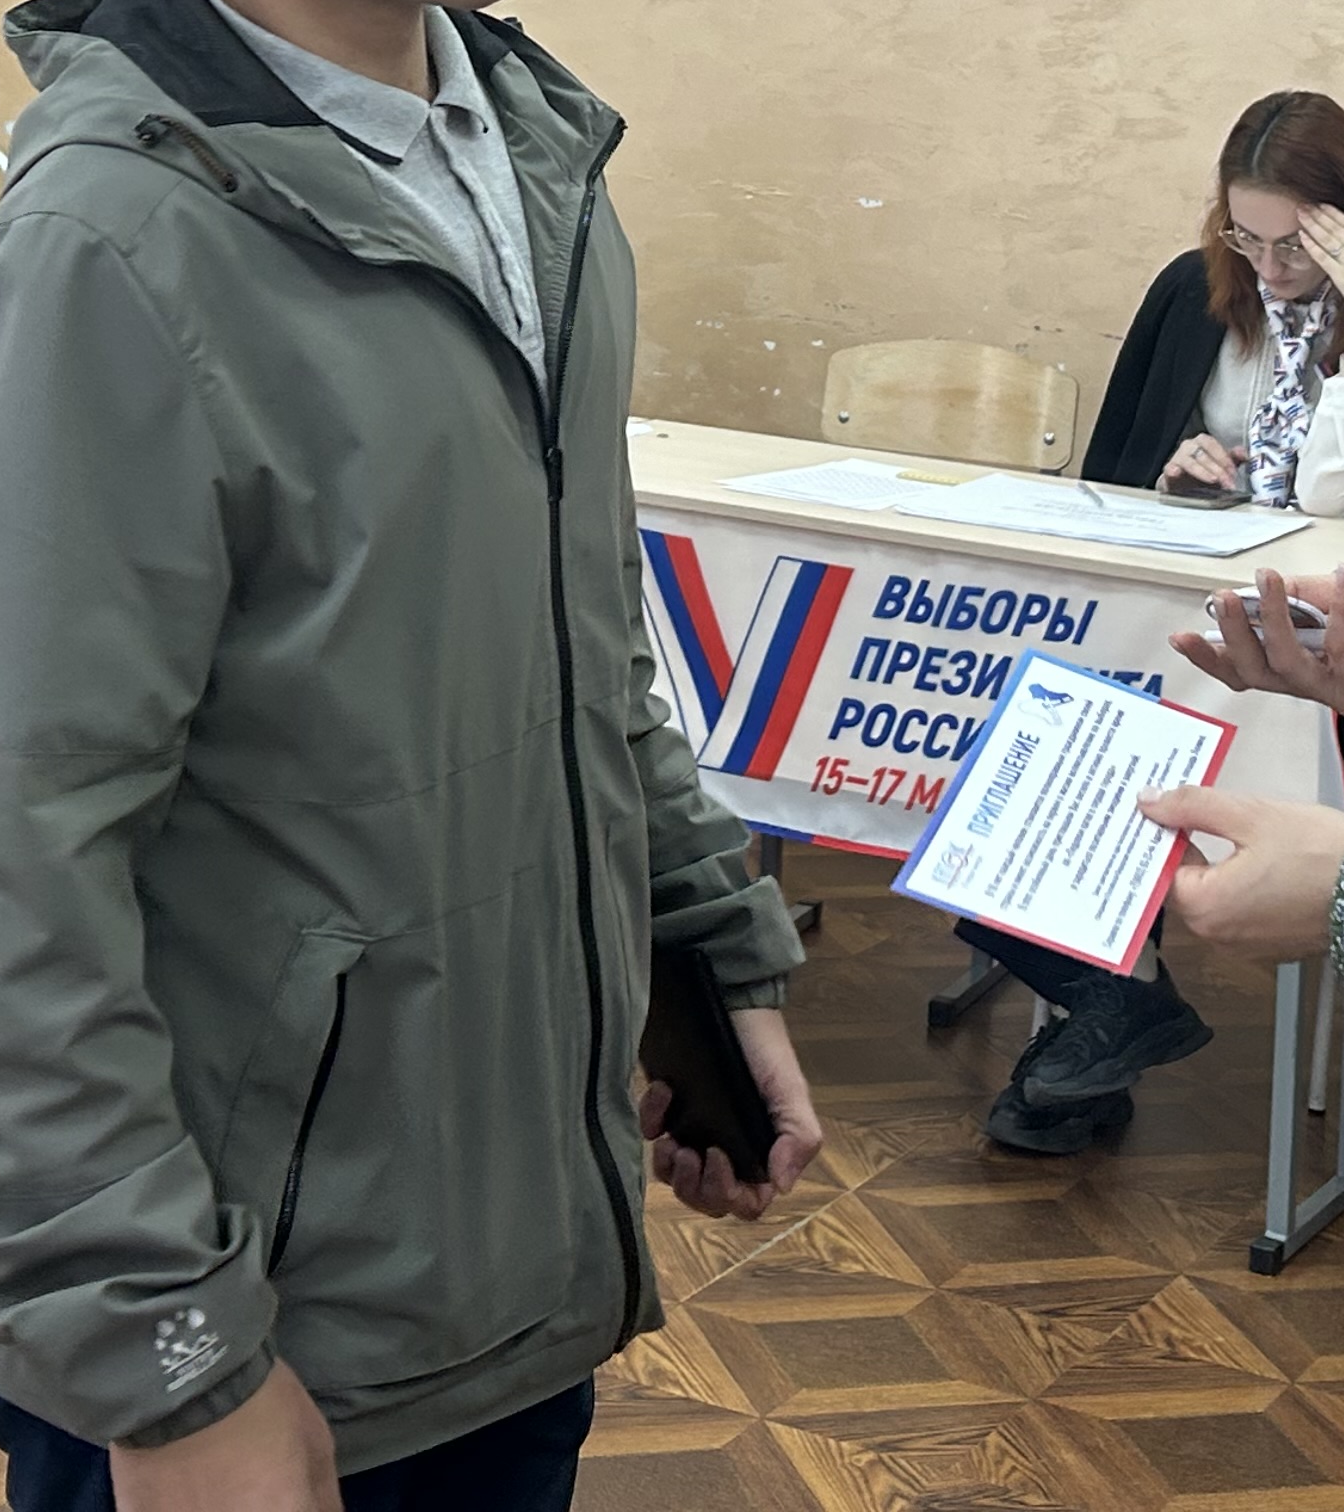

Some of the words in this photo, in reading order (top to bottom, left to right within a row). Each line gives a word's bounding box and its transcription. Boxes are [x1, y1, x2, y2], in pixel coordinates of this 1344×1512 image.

[872, 575, 1097, 645] ВЫБОРЫ
[828, 698, 988, 762] РОССИ
[967, 731, 1040, 838] ПРИГЛАШЕНИЕ
